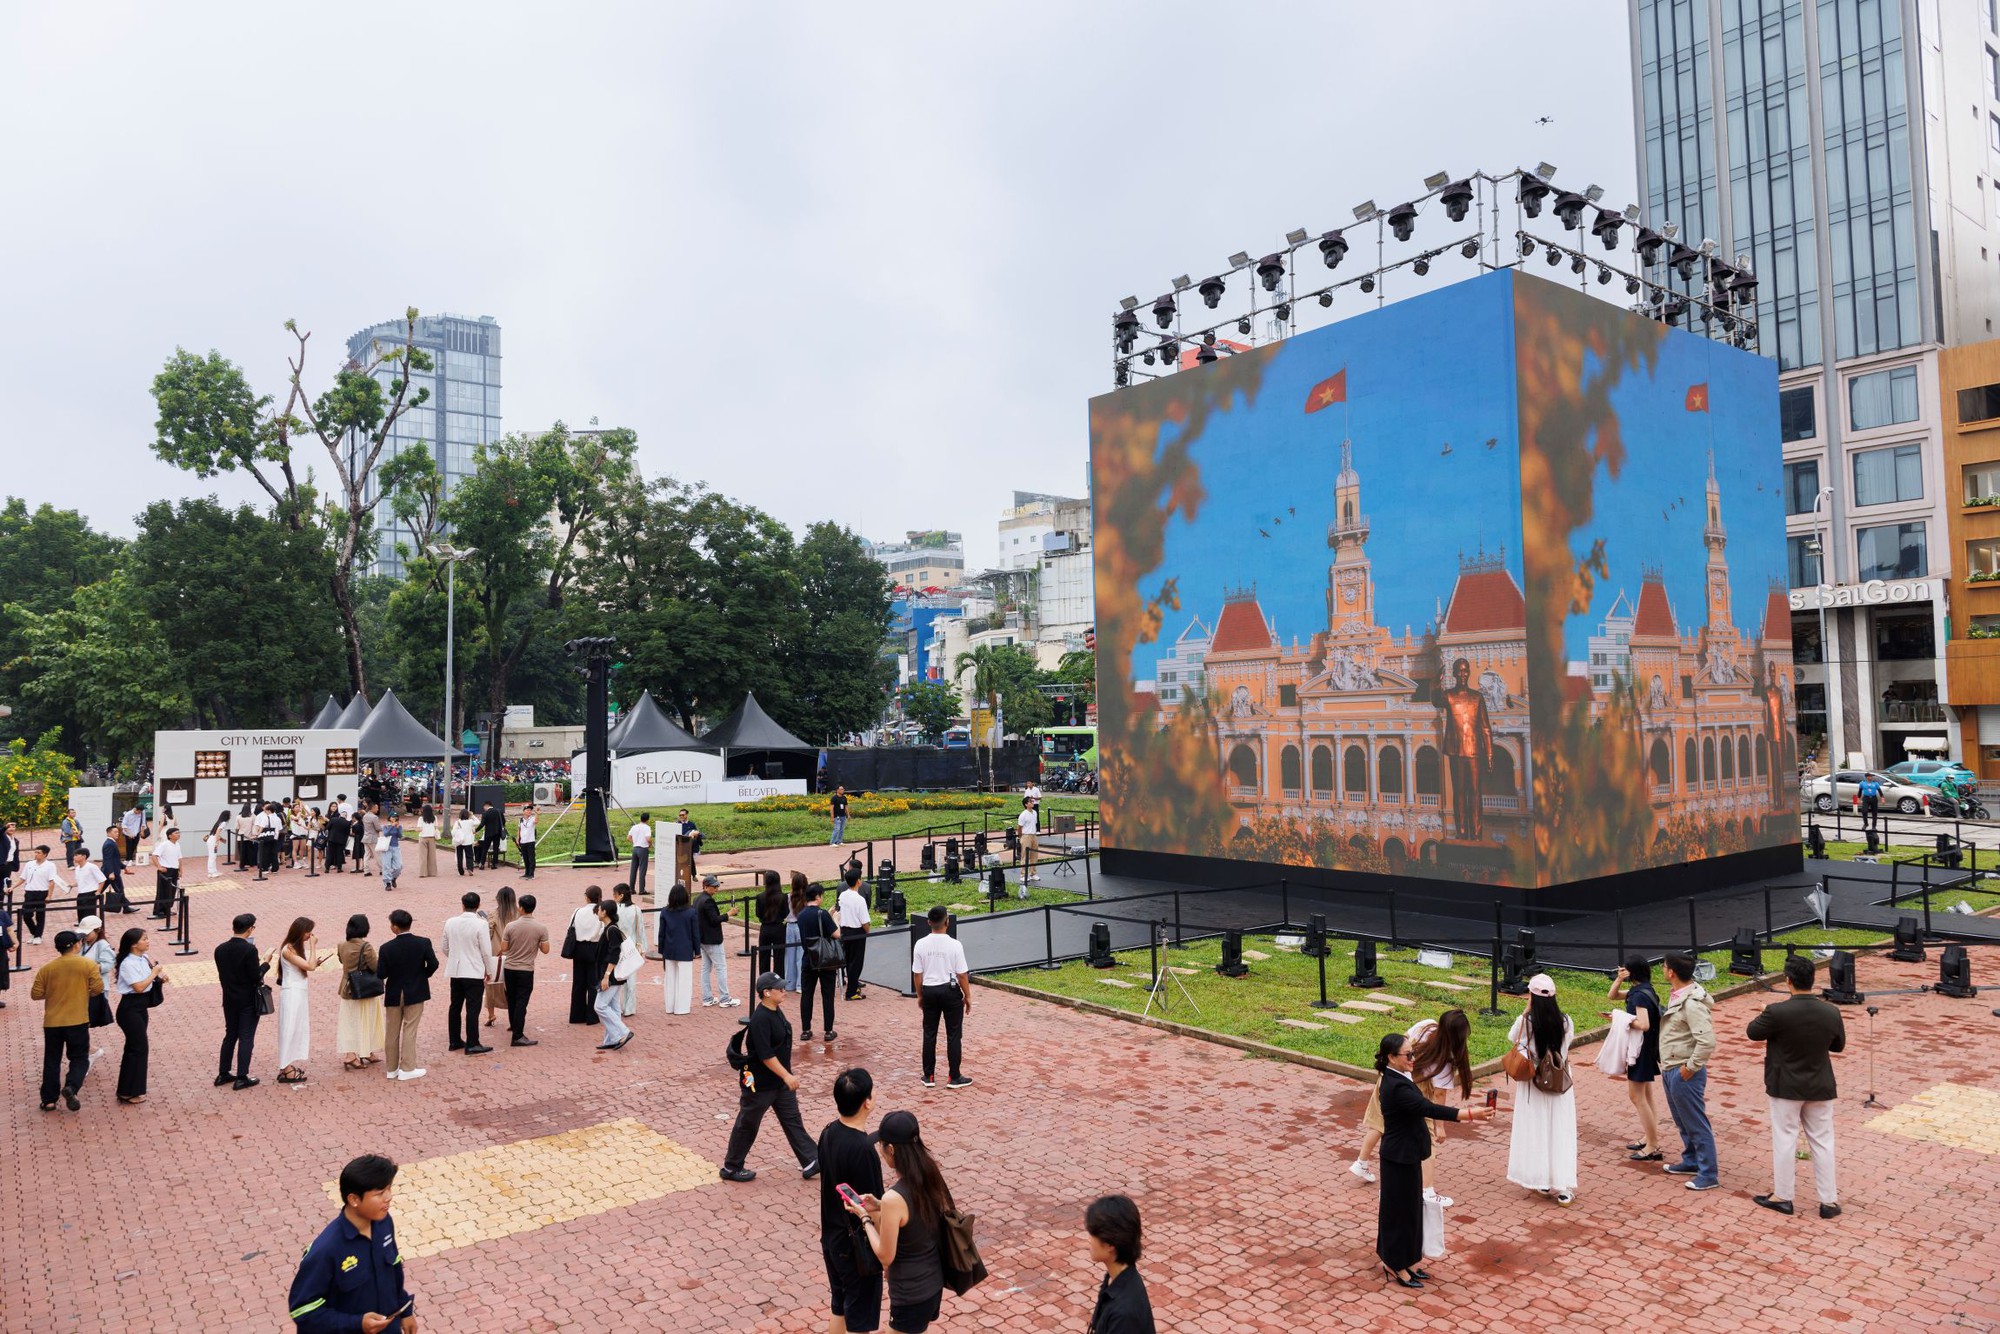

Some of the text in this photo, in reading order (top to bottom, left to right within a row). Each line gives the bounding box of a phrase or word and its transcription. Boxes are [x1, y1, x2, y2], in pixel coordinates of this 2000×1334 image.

[220, 735, 305, 746] CITY MEMORY
[636, 769, 702, 785] BELOVED
[738, 787, 778, 797] BELOVED
